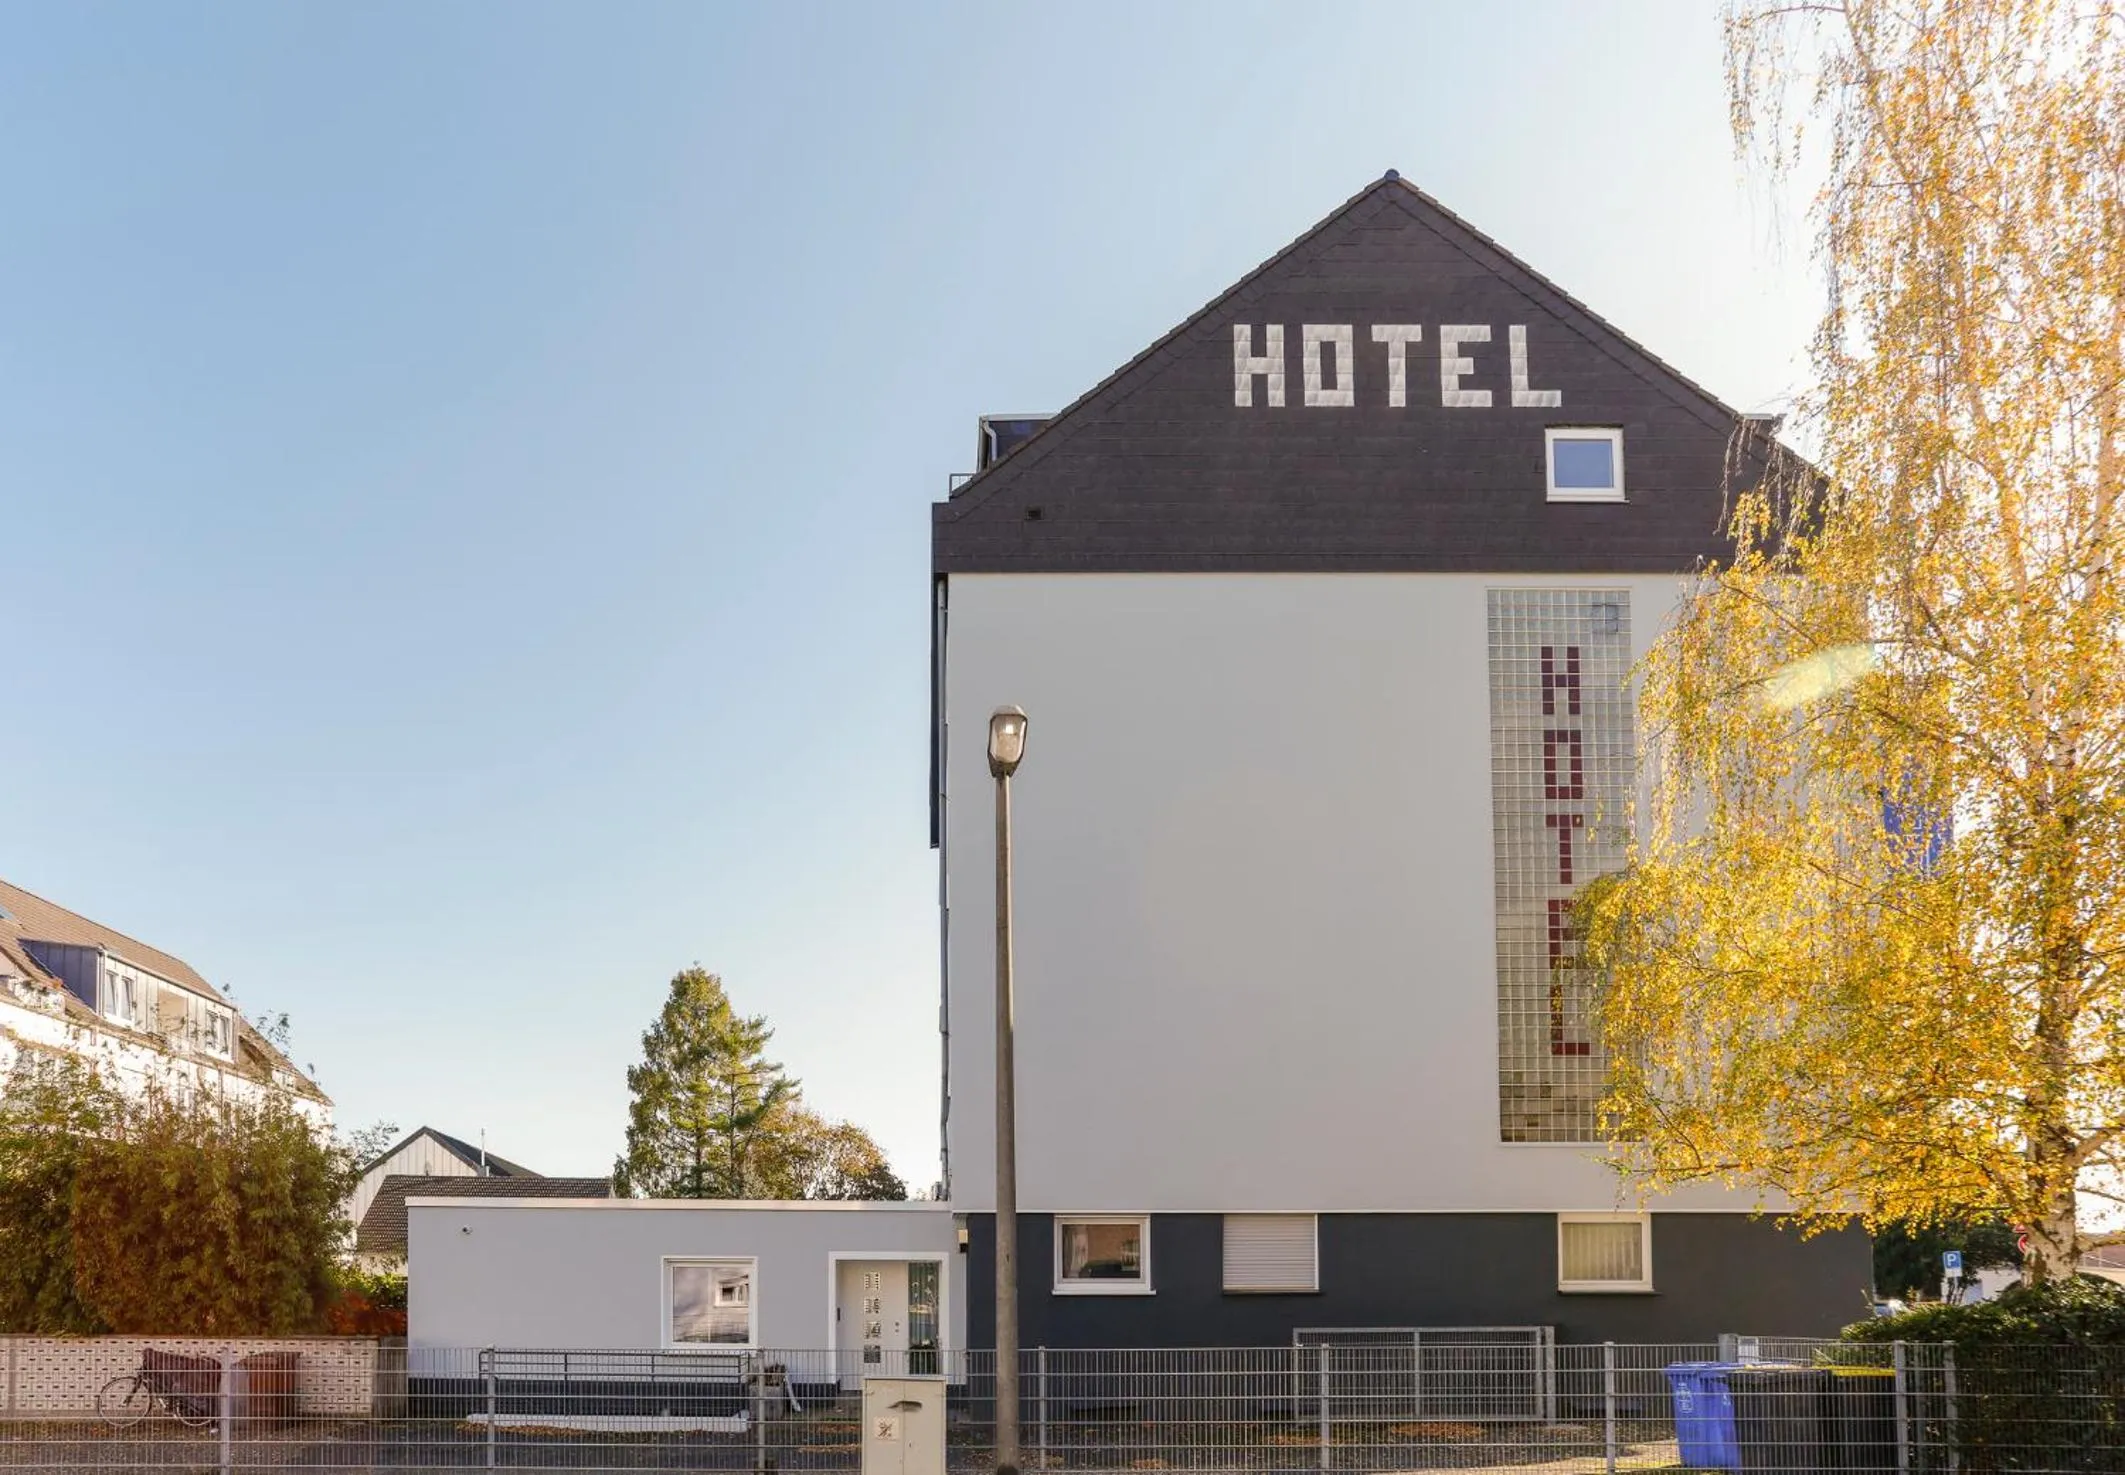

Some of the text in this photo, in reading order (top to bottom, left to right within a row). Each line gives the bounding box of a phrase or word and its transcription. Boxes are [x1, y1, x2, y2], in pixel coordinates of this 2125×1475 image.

[1233, 324, 1562, 408] HOTEL
[1541, 647, 1591, 1056] HOTEL
[1947, 1253, 1957, 1267] P
